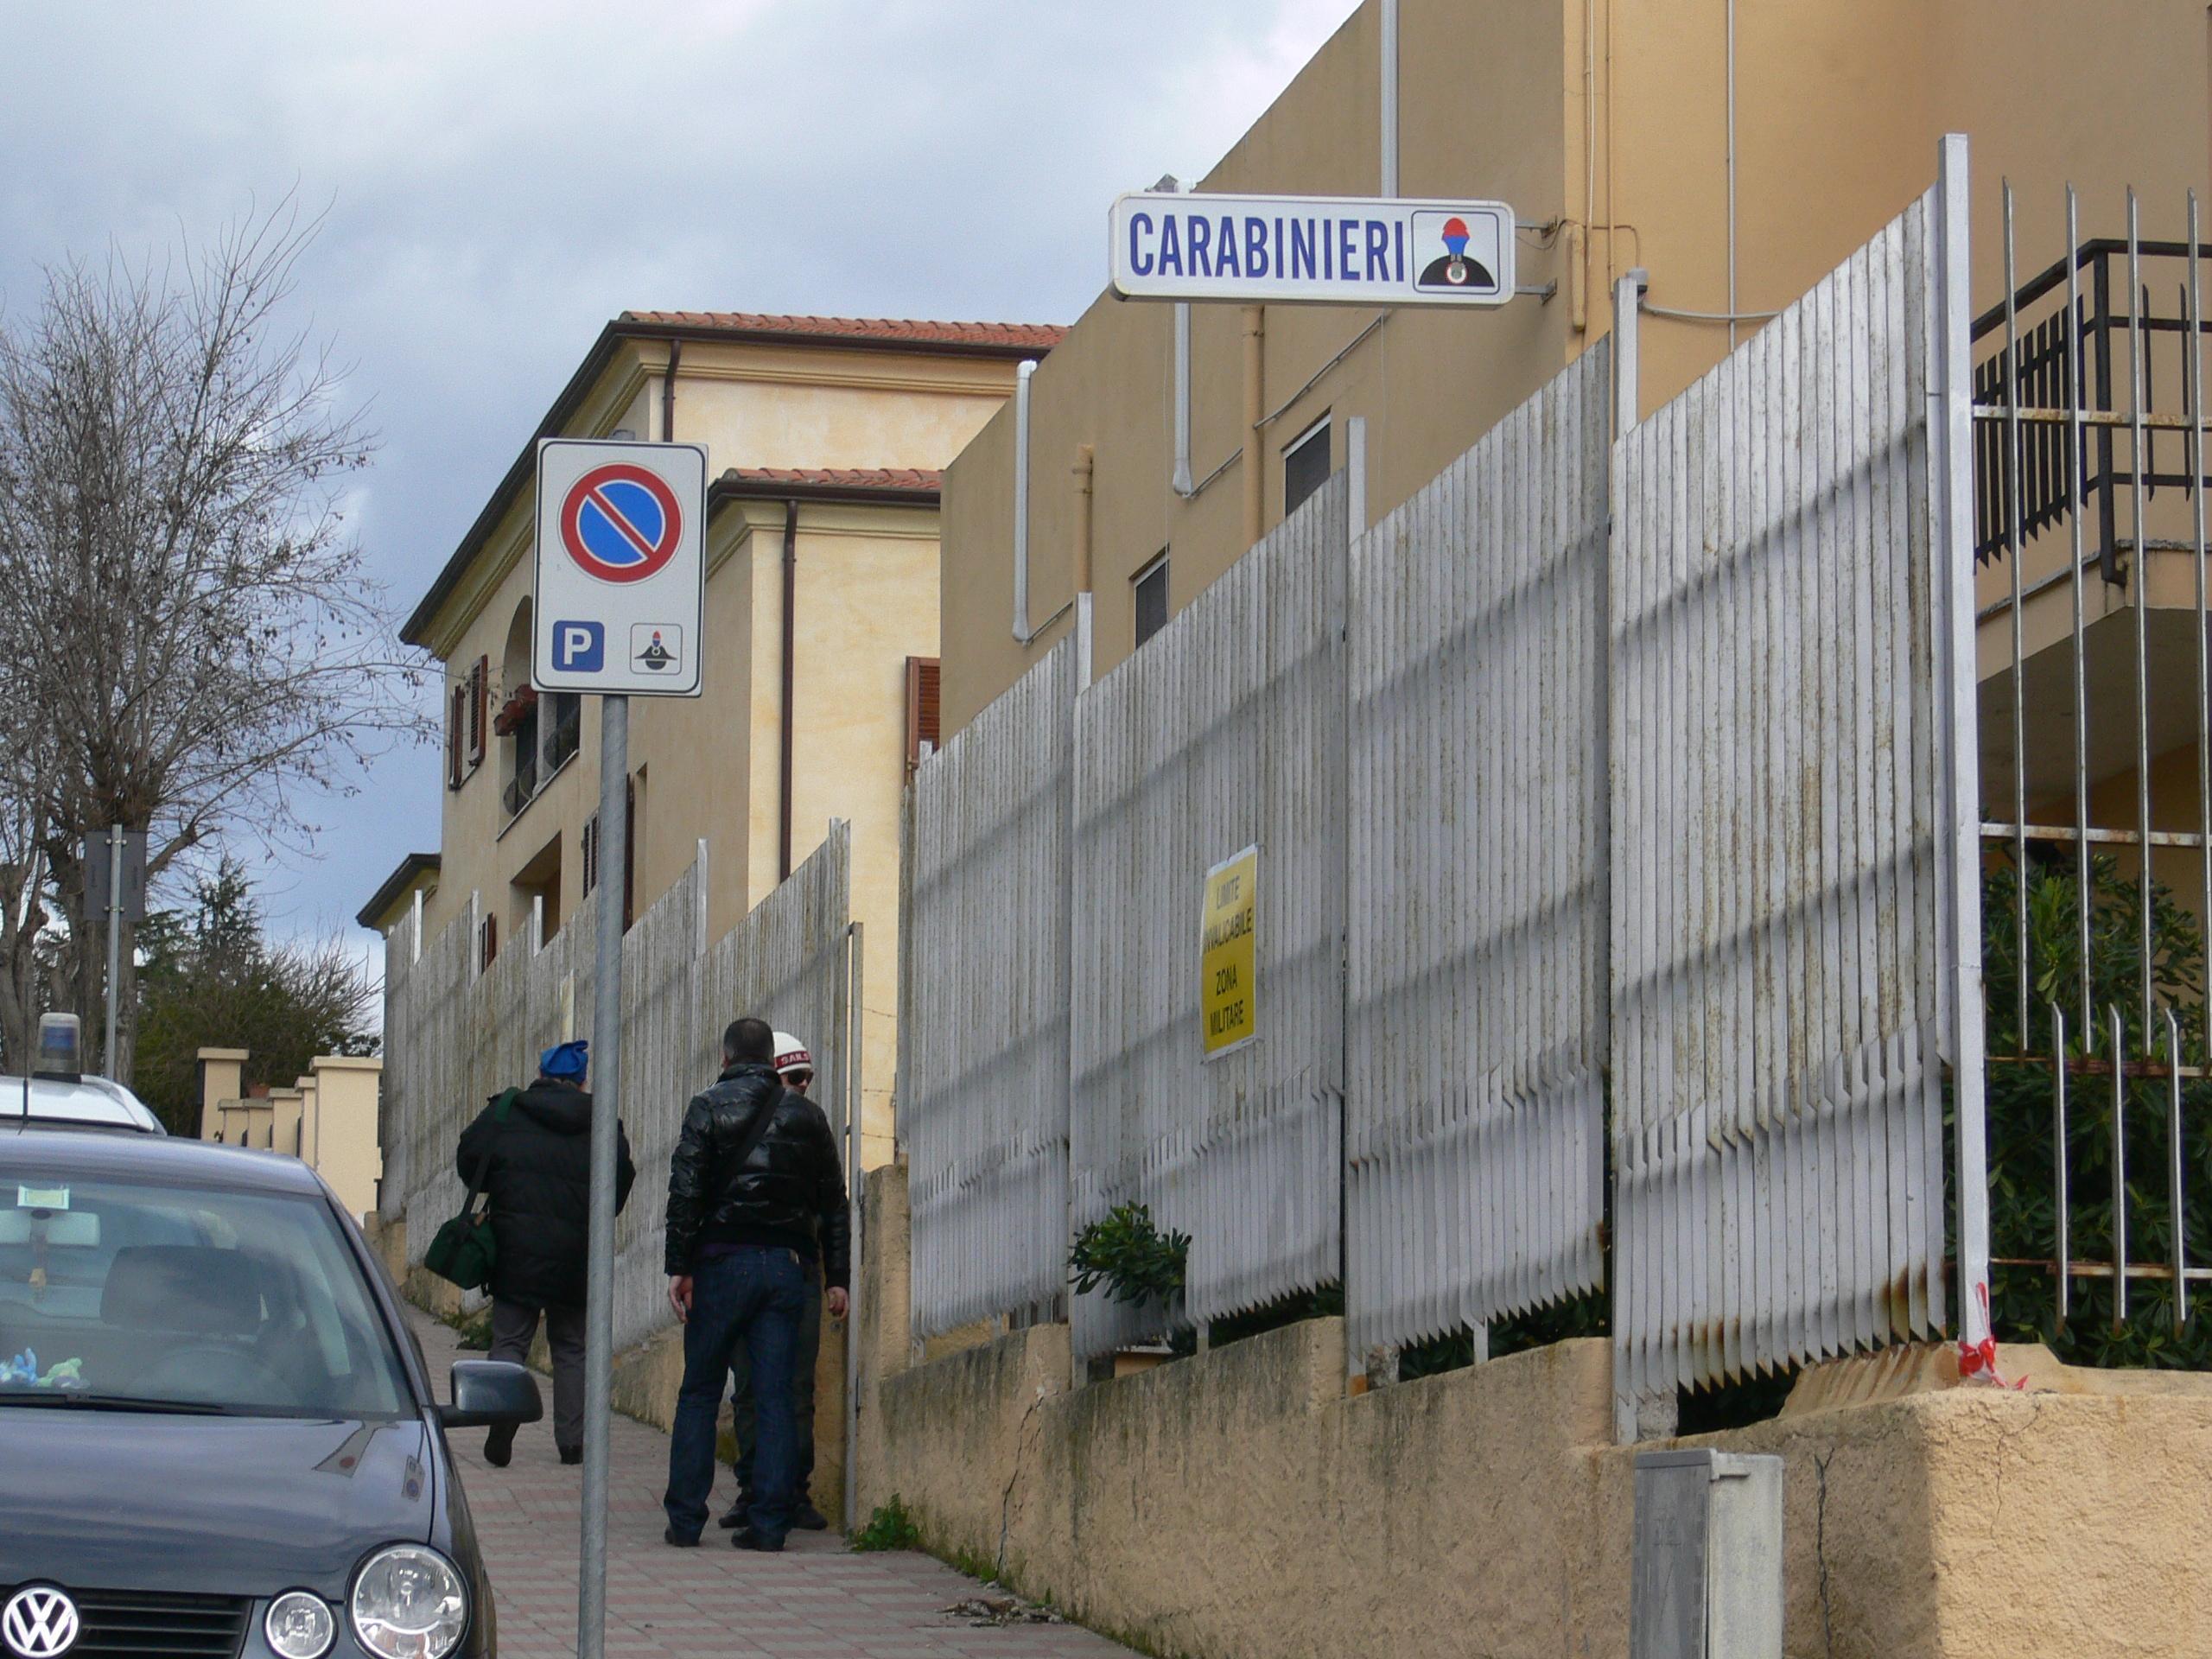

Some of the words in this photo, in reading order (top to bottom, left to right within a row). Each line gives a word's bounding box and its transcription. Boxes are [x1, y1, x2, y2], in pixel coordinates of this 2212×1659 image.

[1129, 212, 1404, 283] CARABINIERI
[563, 627, 593, 665] P
[1216, 875, 1241, 909] LIMITE
[1216, 963, 1238, 996] ZONA
[1210, 999, 1244, 1036] MILITARE
[5, 1589, 76, 1656] VW
